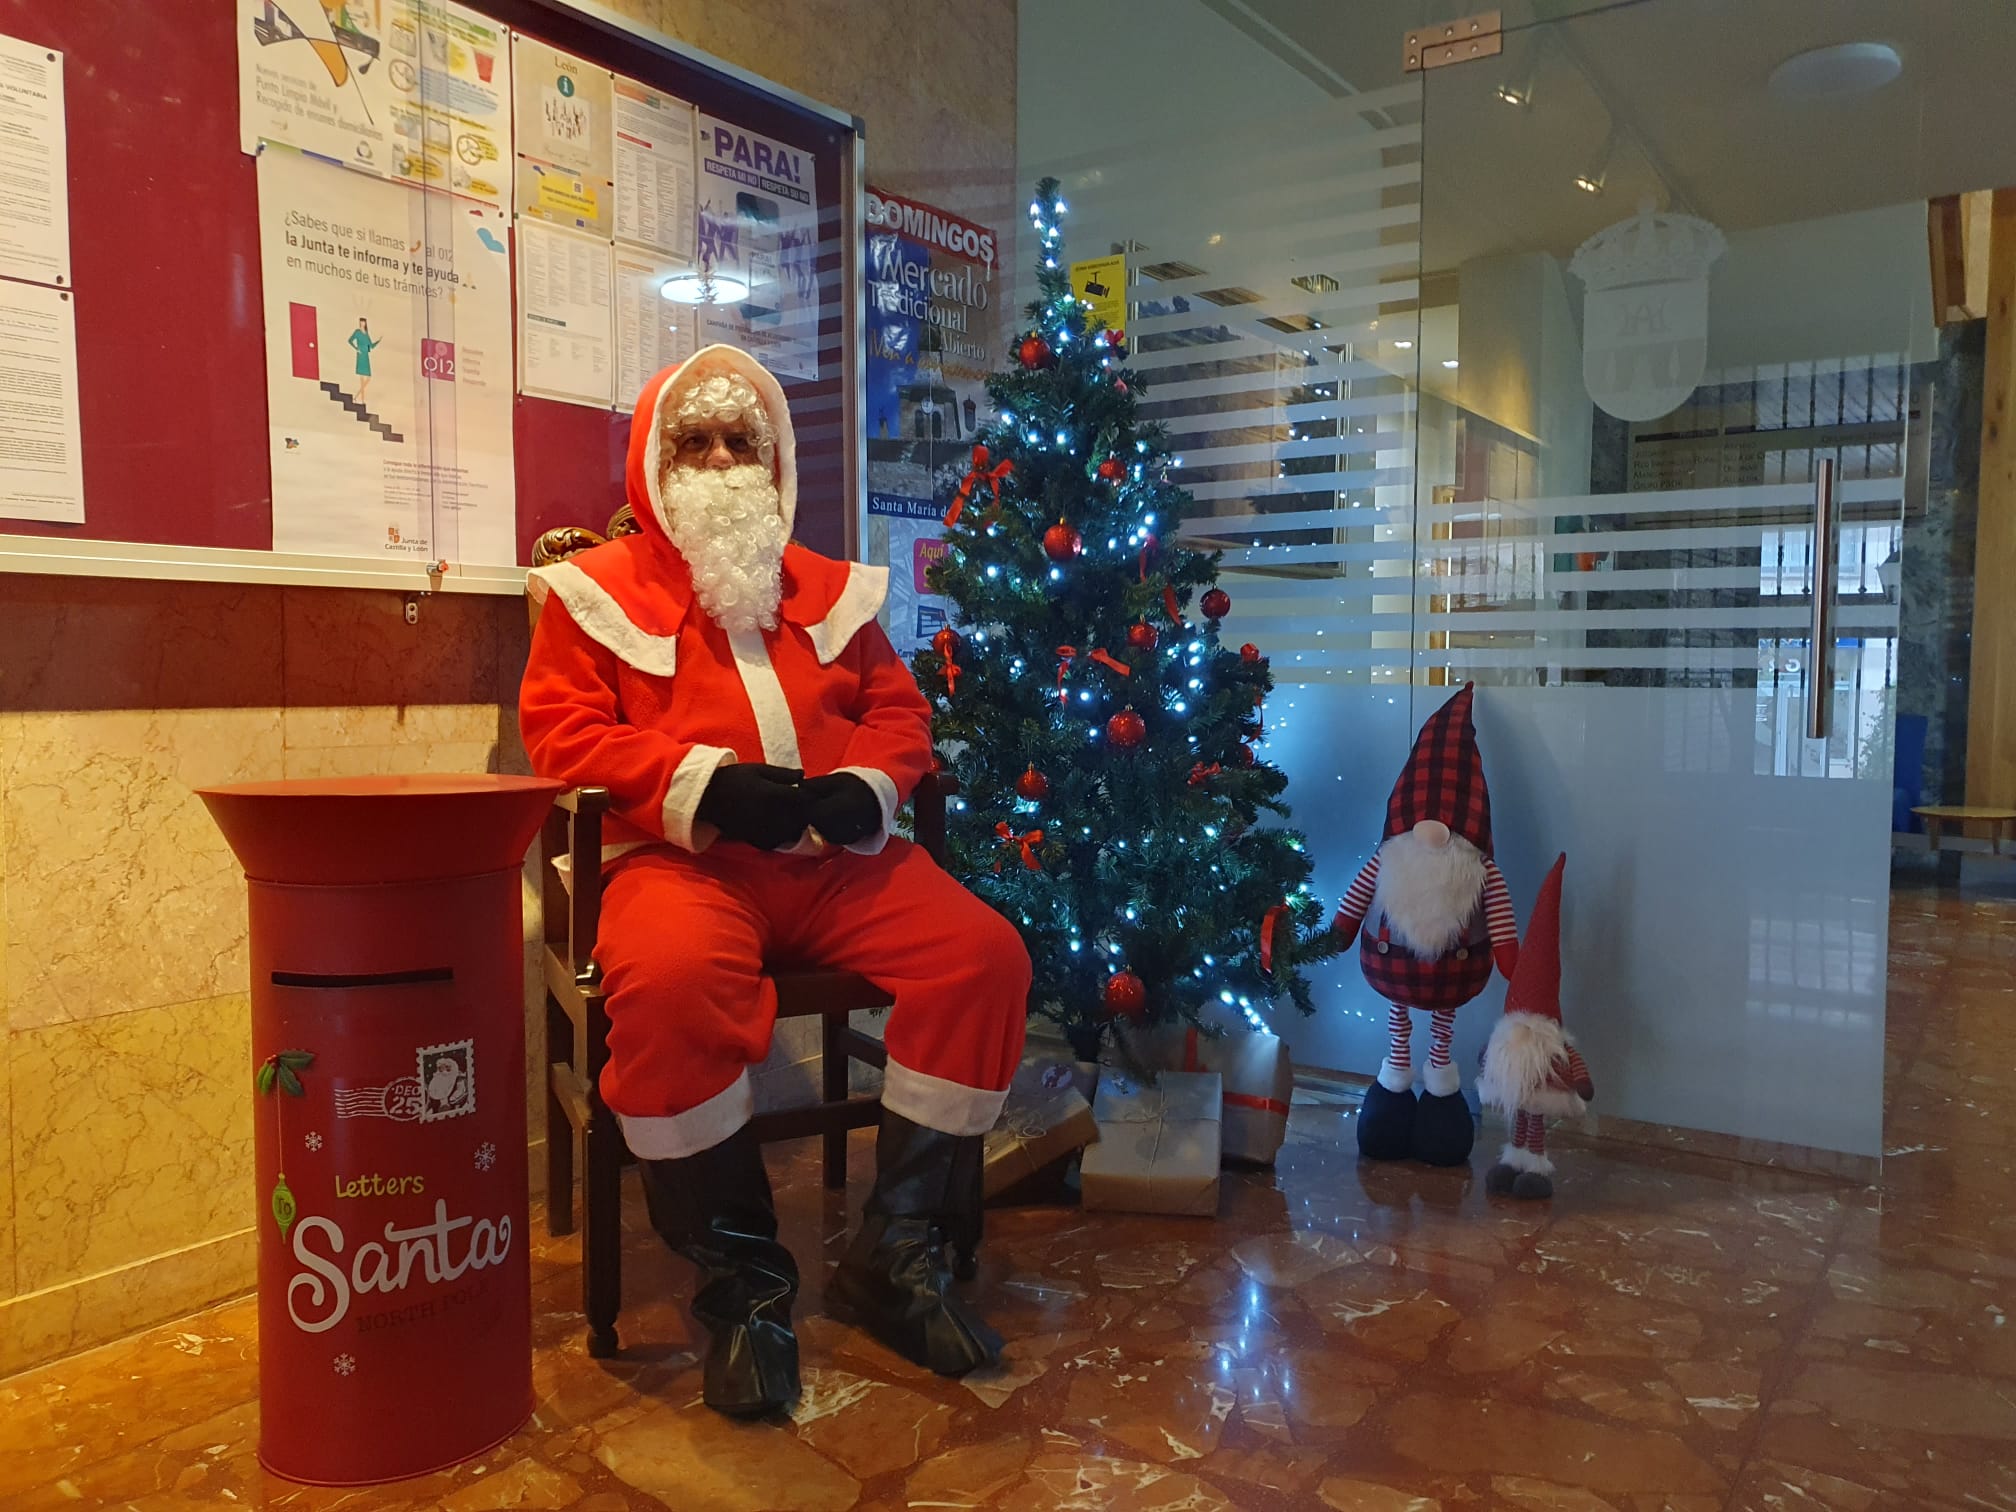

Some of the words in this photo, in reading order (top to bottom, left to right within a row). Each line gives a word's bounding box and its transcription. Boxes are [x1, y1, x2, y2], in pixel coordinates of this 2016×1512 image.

[5, 84, 48, 100] VOLUNTARIA
[714, 126, 800, 184] PARA!
[706, 161, 737, 179] RESPETA
[761, 178, 790, 197] RESPETA
[284, 210, 328, 232] ¿Sabes
[331, 223, 353, 240] que
[356, 227, 366, 240] si
[369, 231, 406, 252] llamas
[426, 245, 436, 258] al
[438, 247, 454, 263] 012
[865, 192, 994, 263] DOMINGOS
[285, 231, 298, 246] la
[301, 233, 335, 255] Junta
[338, 245, 350, 259] te
[353, 247, 399, 270] informa
[402, 262, 410, 276] y
[412, 262, 423, 276] te
[426, 265, 459, 284] ayuda
[286, 256, 301, 269] en
[304, 260, 352, 281] muchos
[355, 269, 370, 284] de
[373, 273, 391, 289] tus
[393, 278, 443, 299] trámites?
[881, 246, 988, 311] Mercado
[868, 279, 968, 334] Tdicional
[424, 356, 455, 375] 012
[872, 496, 903, 514] Santa
[907, 500, 937, 517] María
[385, 543, 406, 551] Castilla
[401, 536, 418, 545] Junta
[390, 1097, 424, 1114] 25
[335, 1173, 425, 1199] Letters
[276, 1198, 292, 1216] To
[287, 1198, 512, 1333] Santa
